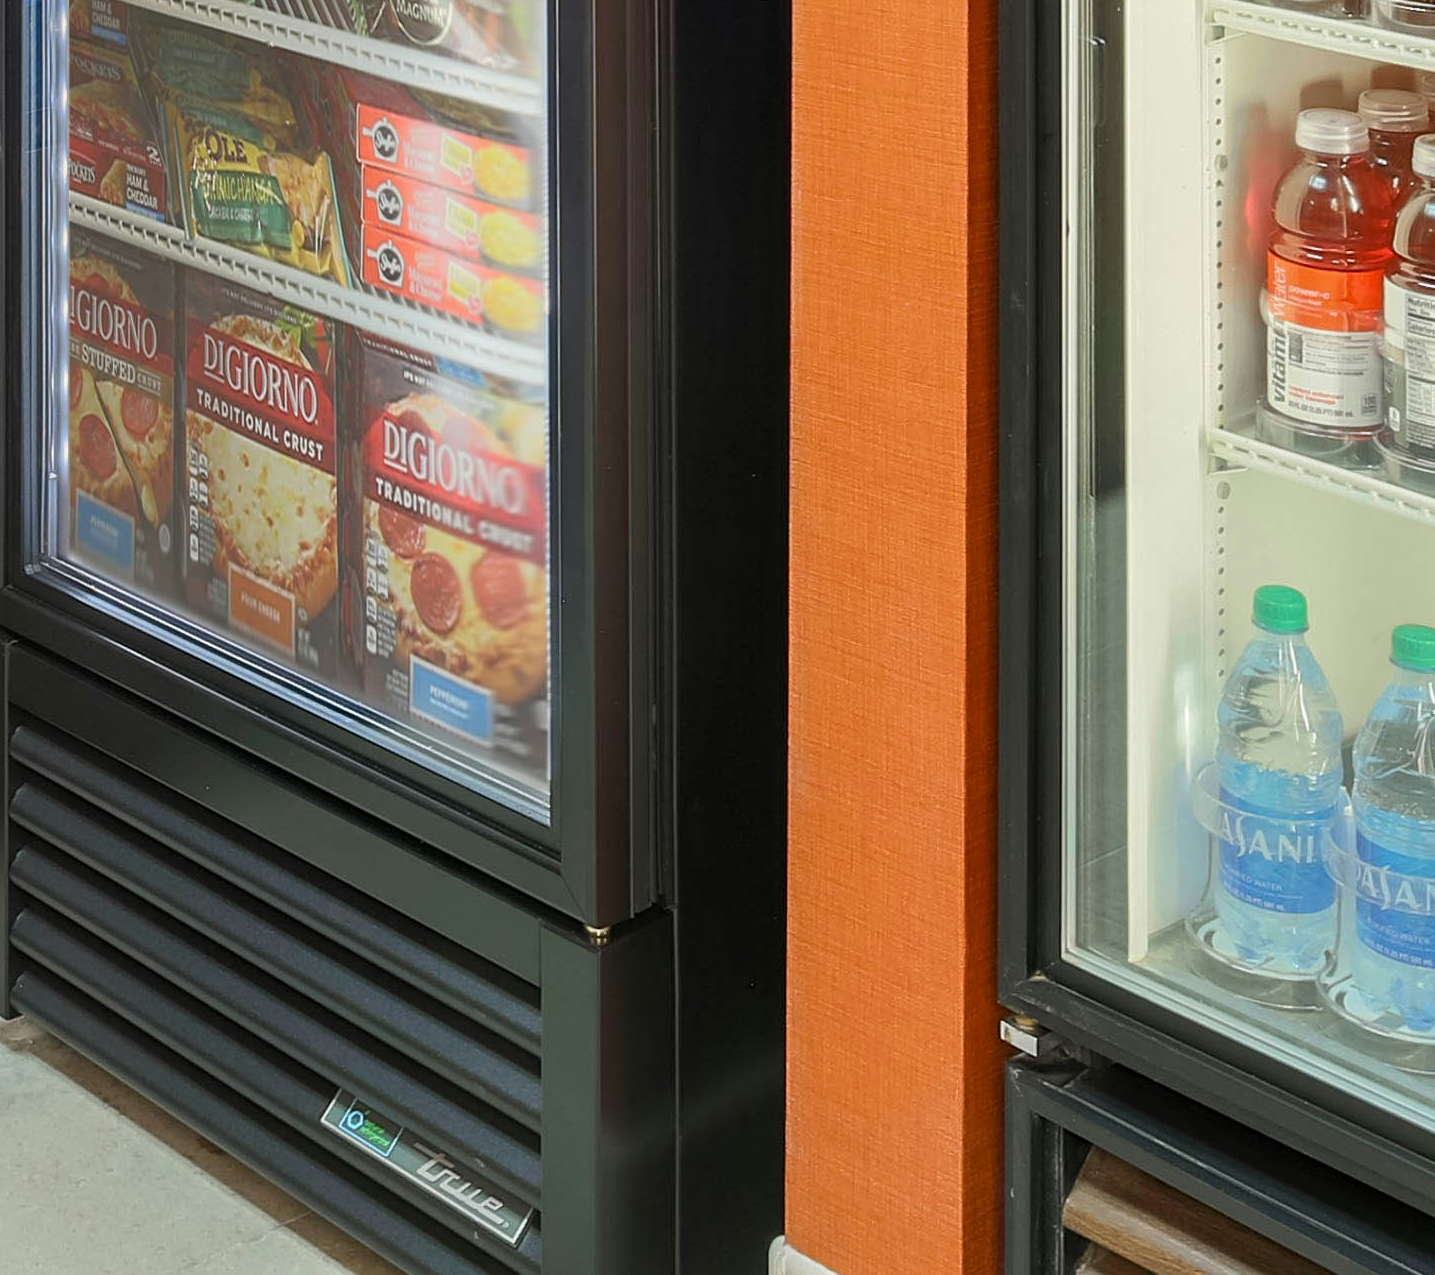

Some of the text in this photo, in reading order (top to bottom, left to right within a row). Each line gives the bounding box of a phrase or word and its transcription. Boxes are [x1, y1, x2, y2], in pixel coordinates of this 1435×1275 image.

[395, 0, 444, 25] MAGNUM
[126, 185, 159, 210] CHEDDAR
[196, 387, 323, 462] TRADITIONAL CRUST
